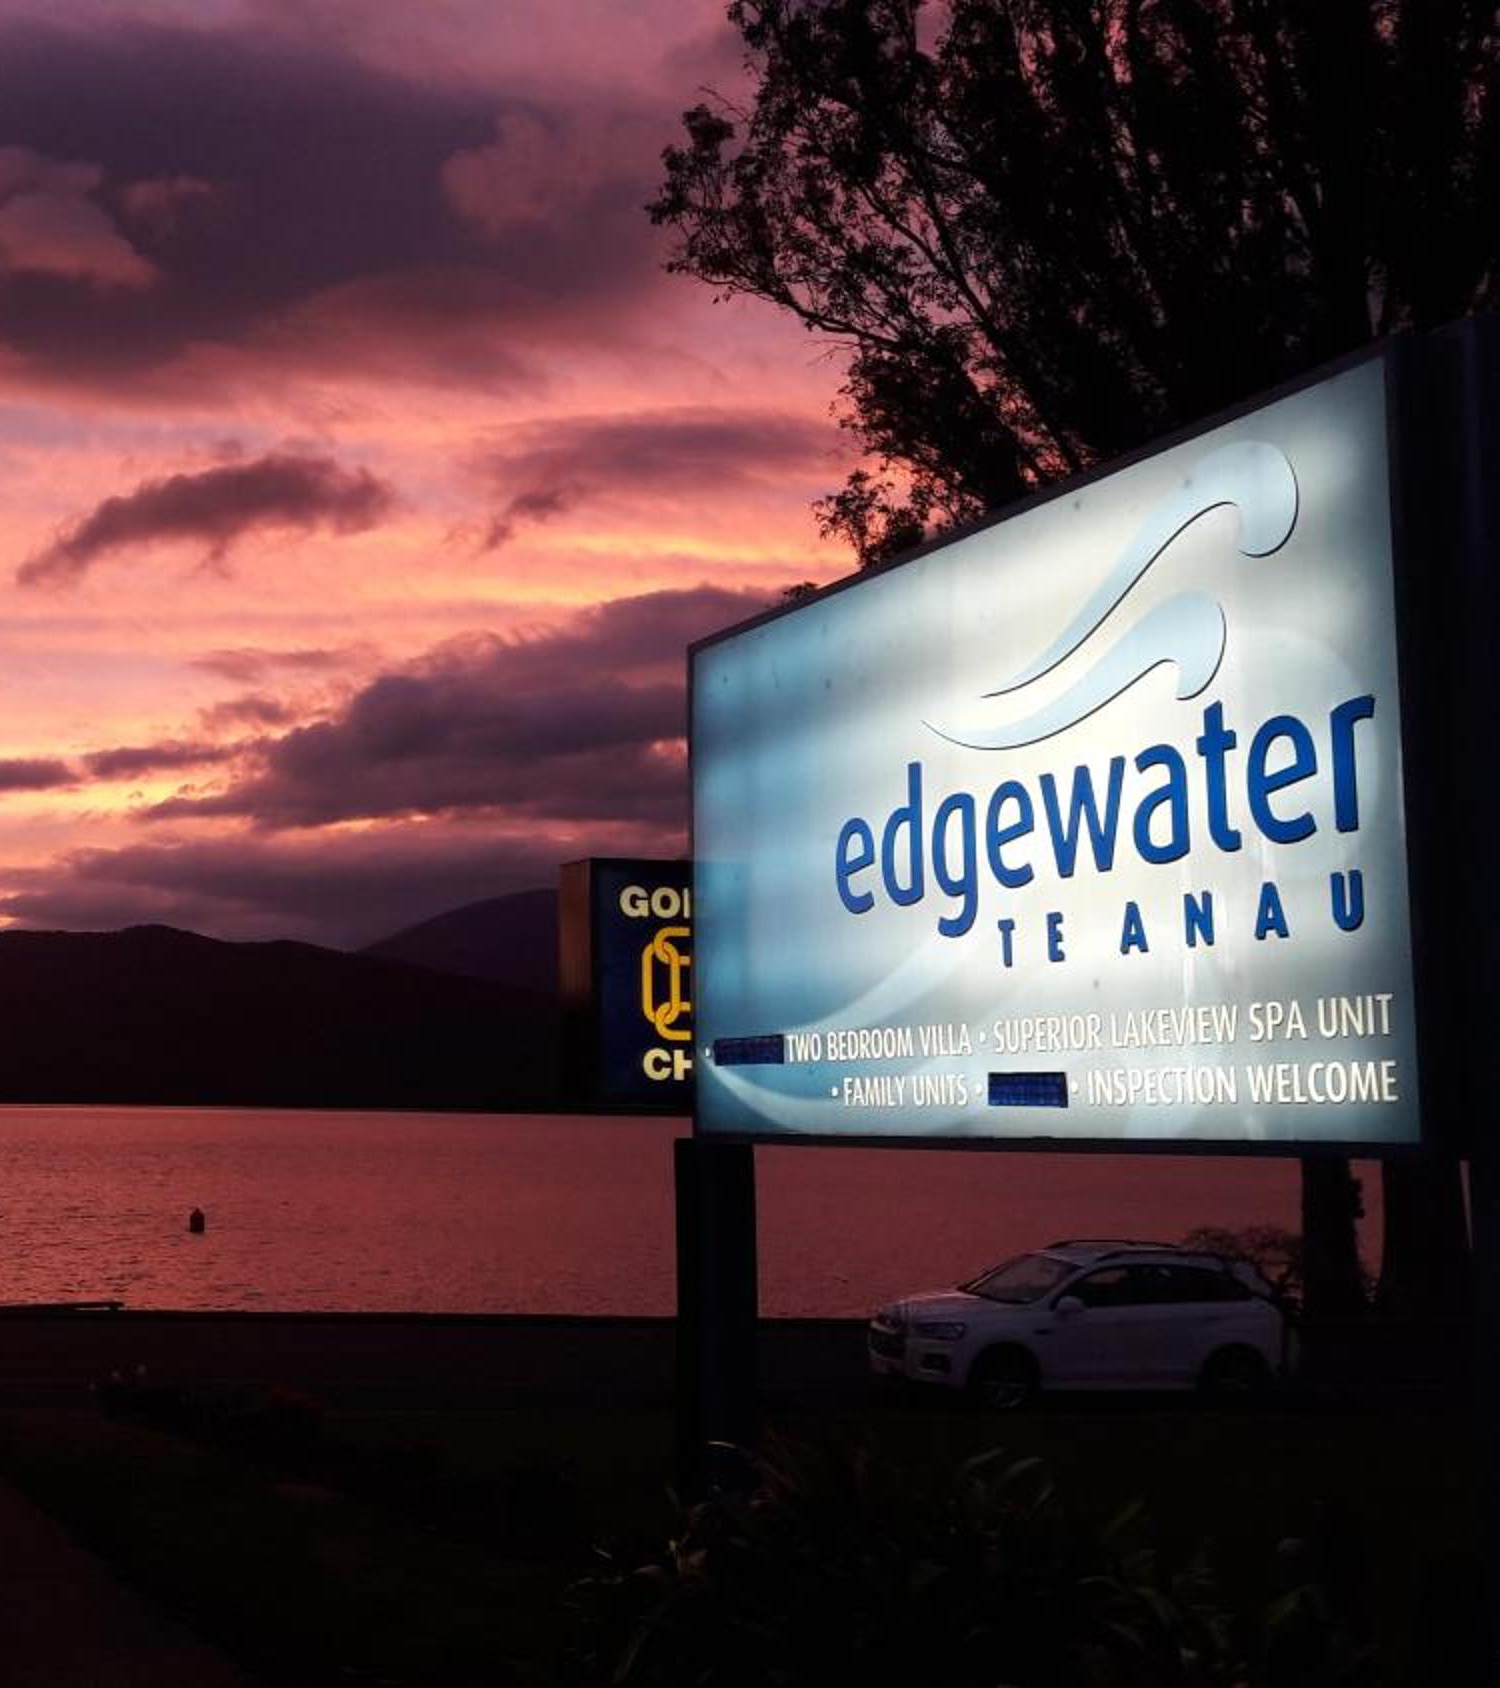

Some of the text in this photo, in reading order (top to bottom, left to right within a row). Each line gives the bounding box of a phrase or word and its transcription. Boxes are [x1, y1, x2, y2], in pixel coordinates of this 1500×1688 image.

[836, 693, 1376, 938] edgewater
[998, 868, 1366, 968] TE ANAU
[786, 992, 1394, 1063] TWO BEDROOM VILLA SUPERIOR LAKEVIEW SPA UNIT
[843, 1059, 1400, 1107] FAMILY UNITS INSPECTION WELCOME
